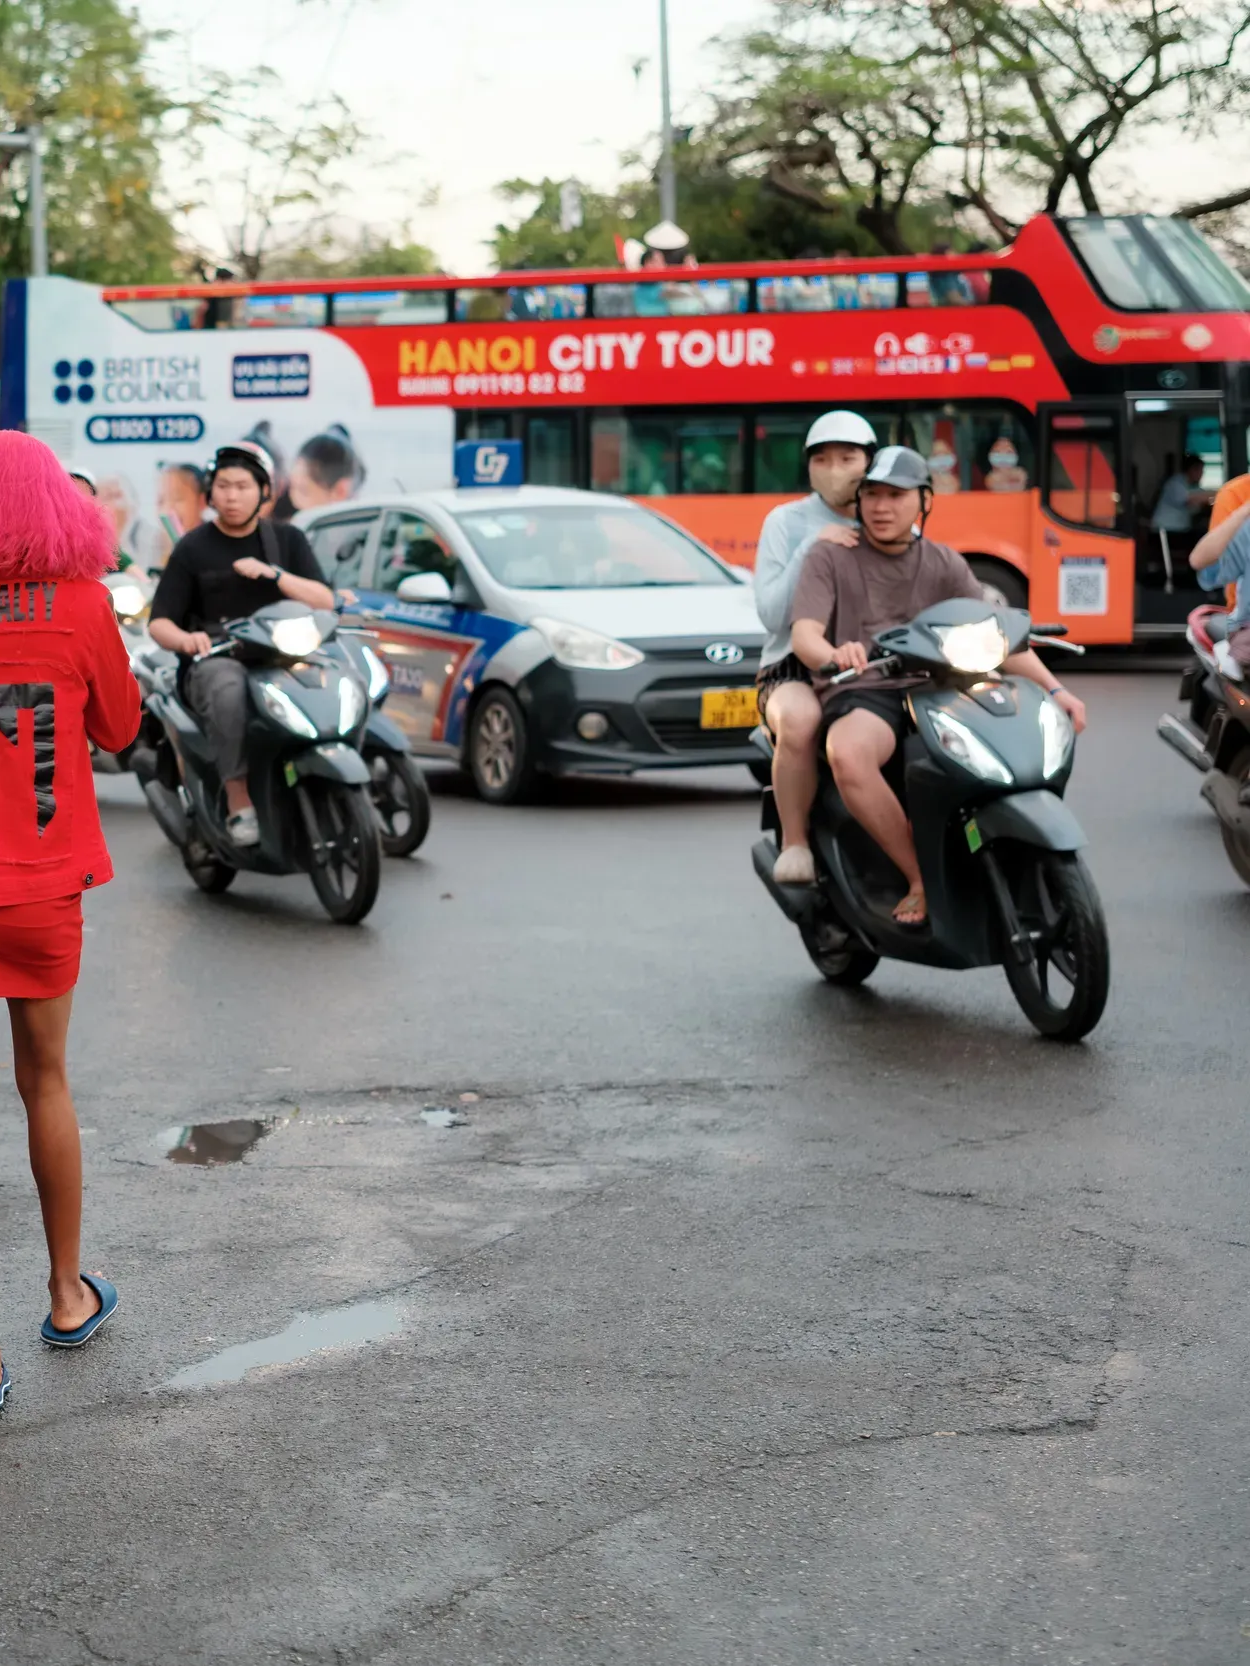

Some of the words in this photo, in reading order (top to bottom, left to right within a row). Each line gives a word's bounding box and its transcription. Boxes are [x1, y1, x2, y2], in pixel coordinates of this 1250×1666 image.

[399, 336, 536, 374] HANOI
[548, 332, 646, 372] CITY
[656, 328, 775, 368] TOUR
[104, 356, 201, 379] BRITISH
[102, 381, 207, 403] COUNCIL
[475, 446, 510, 483] G7
